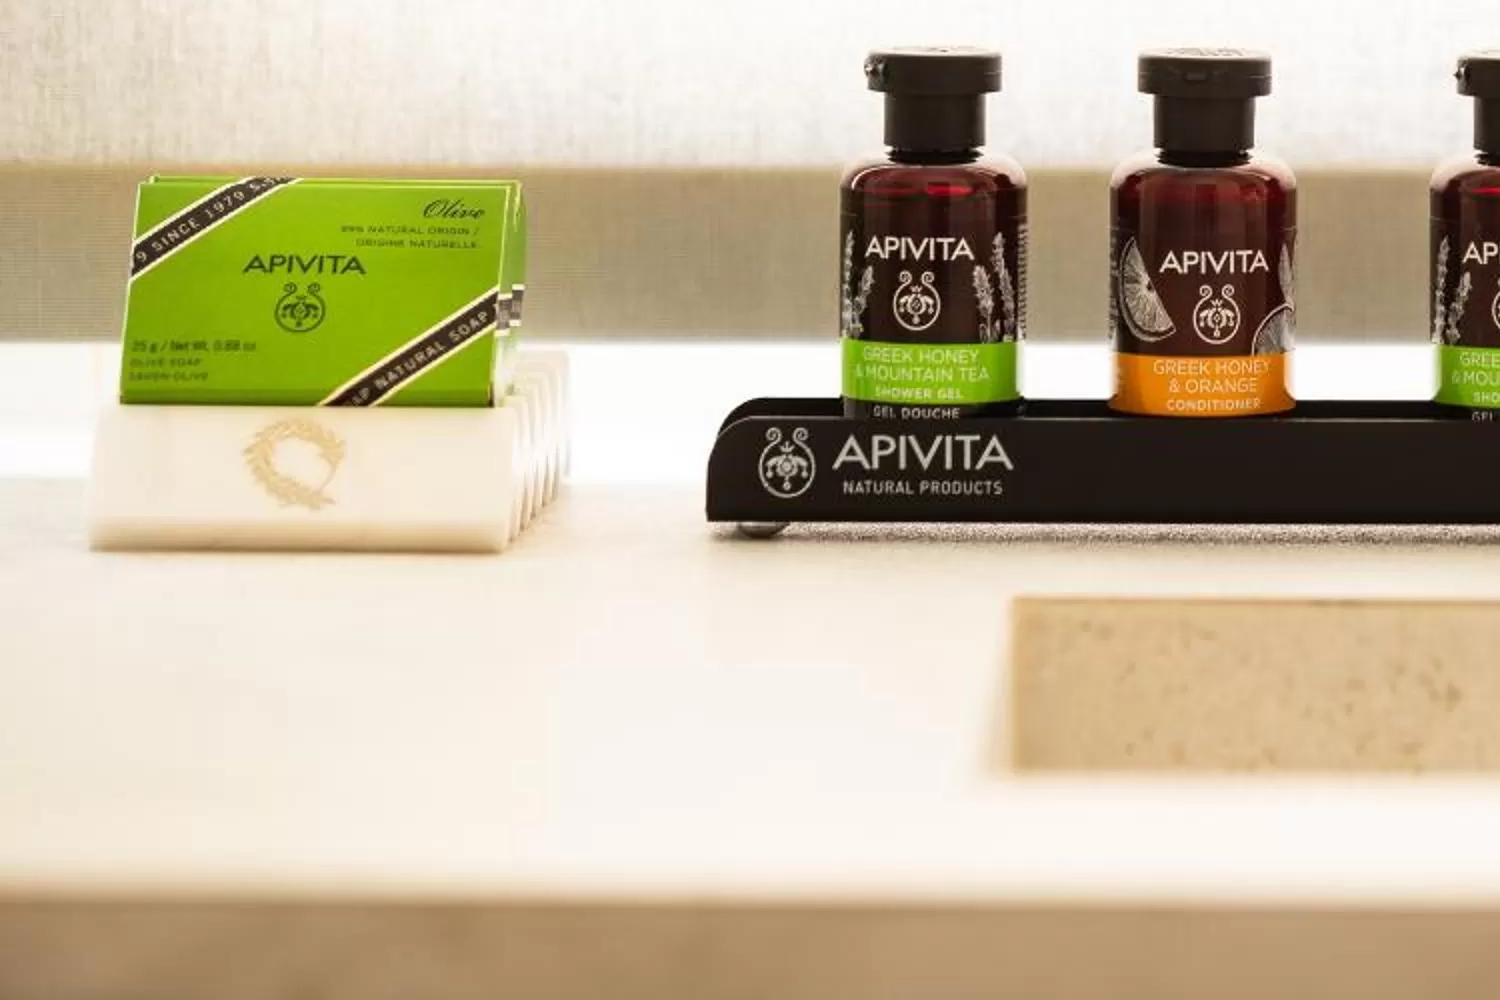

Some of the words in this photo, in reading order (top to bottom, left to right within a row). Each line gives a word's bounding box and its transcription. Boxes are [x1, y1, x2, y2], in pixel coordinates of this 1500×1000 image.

[423, 197, 485, 220] Olive
[151, 217, 200, 252] SINCE
[204, 190, 245, 219] 1979
[367, 225, 423, 235] NATURAL
[427, 226, 469, 236] ORIGIN
[409, 239, 477, 250] NATURELLE
[865, 235, 976, 261] APIVITA
[242, 254, 367, 276] APIVITA
[1159, 250, 1269, 275] APIVITA
[373, 341, 447, 389] NATURAL
[448, 310, 489, 343] SOAP
[863, 346, 913, 364] GREEK
[919, 348, 981, 365] HONEY
[865, 364, 954, 382] MOUNTAIN
[959, 367, 990, 382] TEA
[1153, 359, 1212, 376] GREEK
[1215, 359, 1270, 376] HONEY
[875, 386, 933, 400] SHOWER
[937, 388, 964, 401] GEL
[1168, 377, 1180, 393] &
[1185, 377, 1258, 394] ORANGE
[873, 405, 897, 419] GEL
[901, 407, 961, 420] DOUCHE
[1166, 398, 1262, 412] CONDITIONER
[831, 434, 1015, 472] APIVITA
[843, 479, 914, 496] NATURAL
[919, 479, 1004, 497] PRODUCTS
